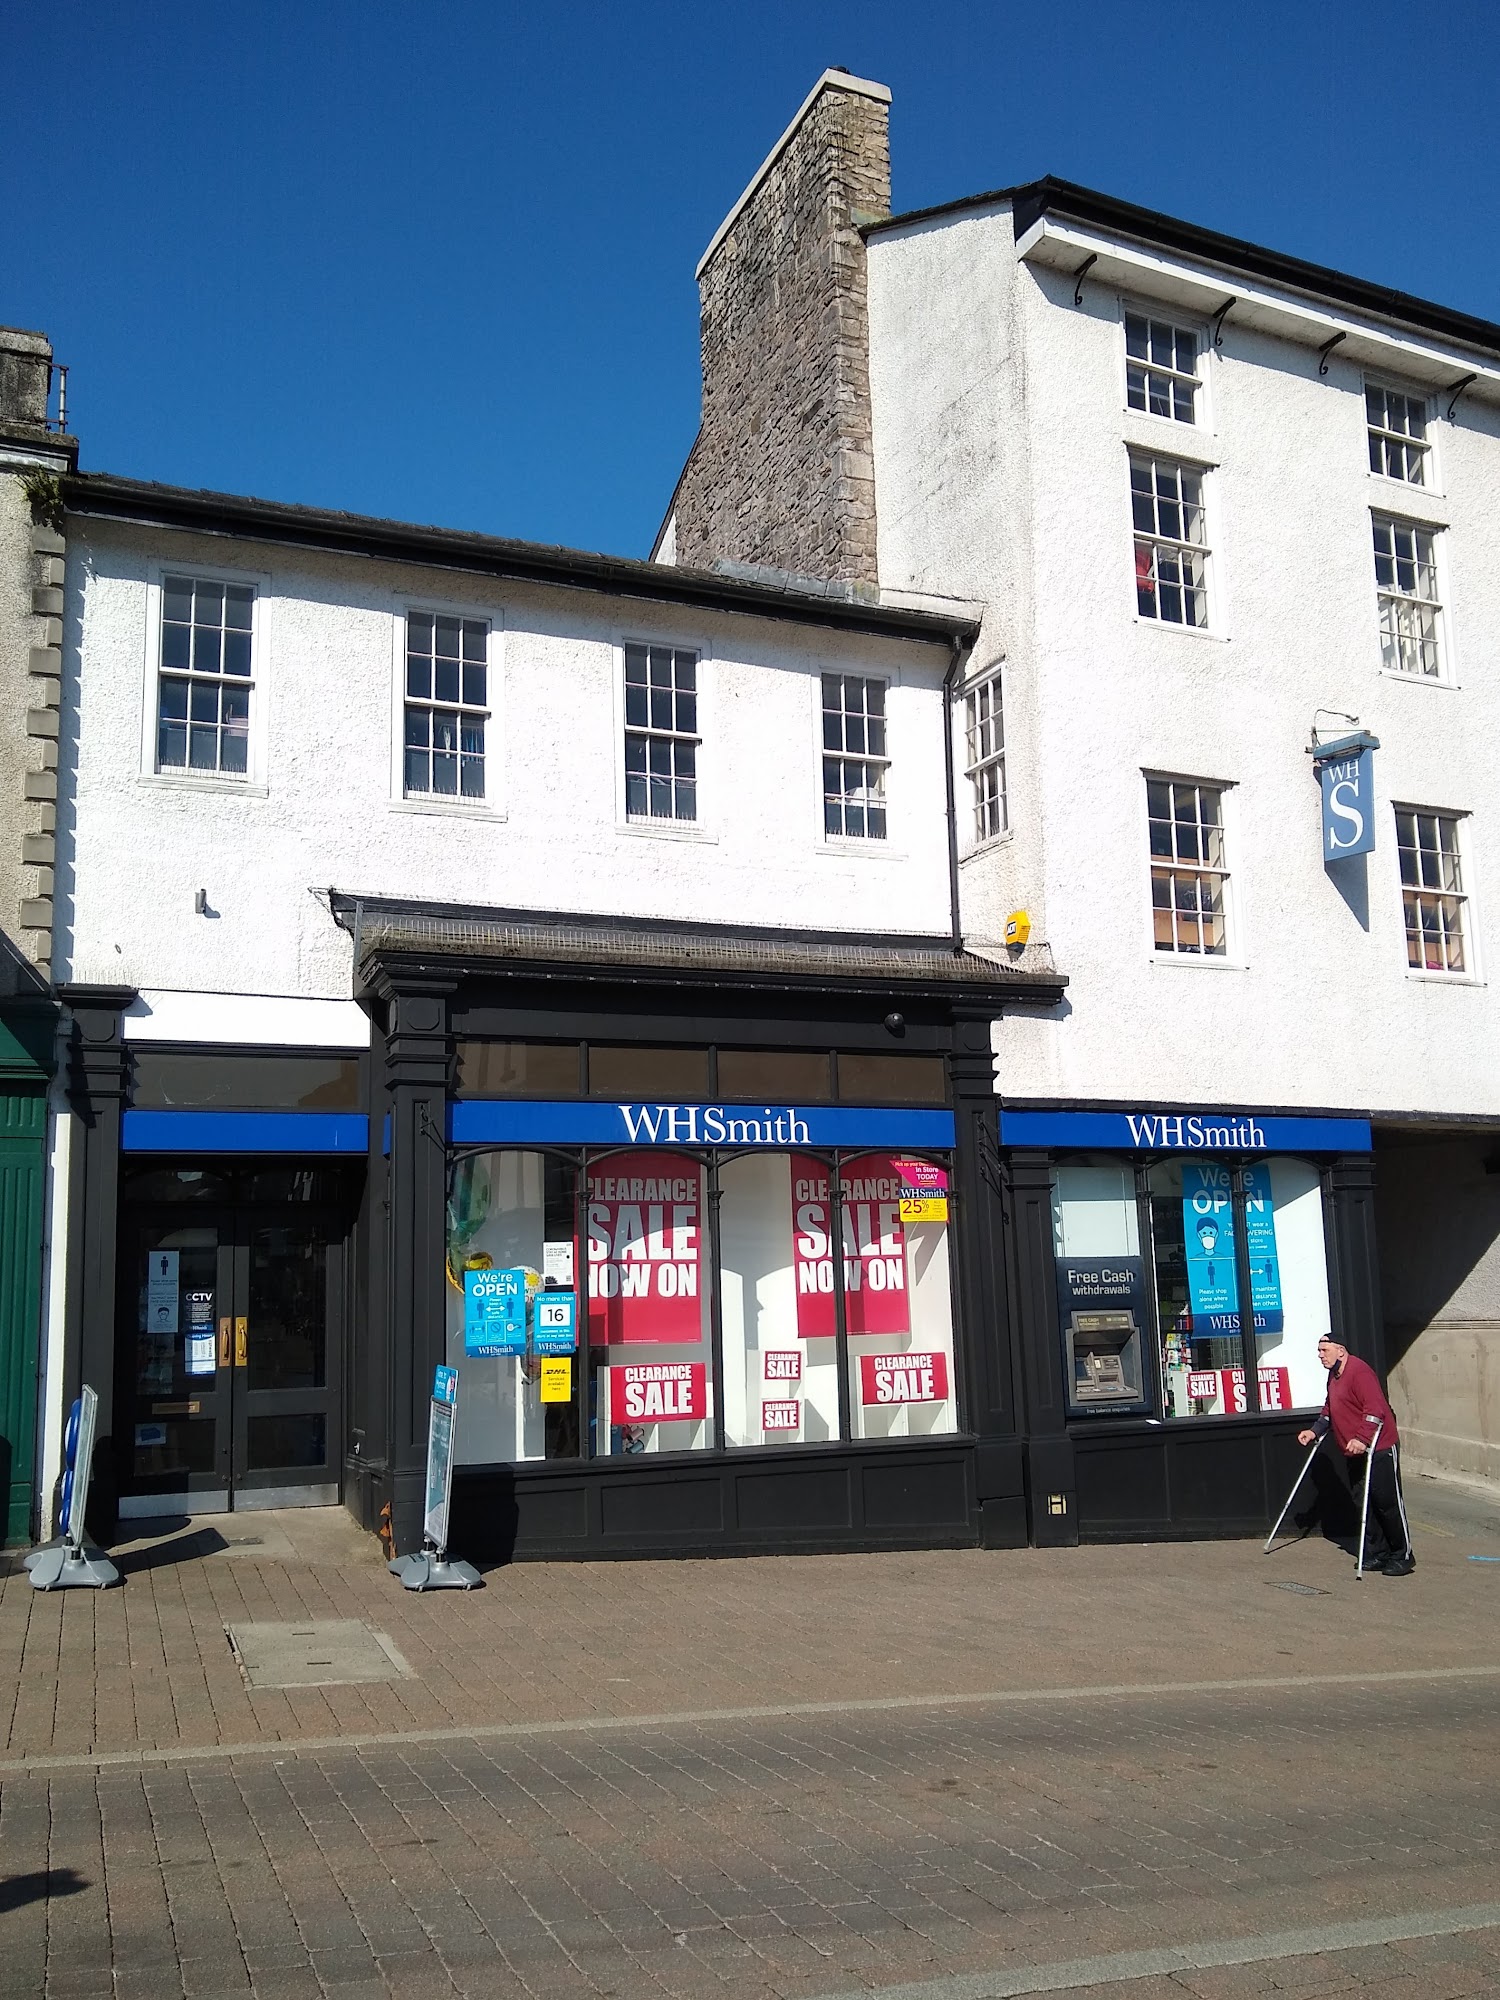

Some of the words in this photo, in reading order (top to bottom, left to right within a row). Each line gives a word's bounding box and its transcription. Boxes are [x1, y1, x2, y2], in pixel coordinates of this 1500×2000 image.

[1328, 759, 1360, 783] WH
[1330, 779, 1364, 850] S
[618, 1105, 812, 1144] WHSmith
[1125, 1115, 1267, 1148] WHSmith
[587, 1177, 697, 1202] CLEARANCE
[795, 1178, 899, 1202] CLERANCE
[900, 1188, 945, 1198] WHSmith
[1192, 1189, 1264, 1214] OPN
[588, 1203, 698, 1261] SALE
[477, 1272, 513, 1283] We're
[657, 1263, 697, 1297] ON
[868, 1258, 904, 1291] ON
[1067, 1270, 1099, 1284] Free
[1101, 1269, 1134, 1283] Cash
[185, 1292, 213, 1301] CCTV
[472, 1282, 518, 1297] OPEN
[1072, 1284, 1131, 1295] withdrawals
[547, 1308, 564, 1322] 16
[478, 1345, 514, 1354] WHSmith
[537, 1342, 572, 1351] WHSmith
[767, 1361, 799, 1378] SALE
[874, 1355, 933, 1371] CLEARANCE
[625, 1365, 692, 1383] CLEARANCE
[875, 1369, 934, 1402] SALE
[1191, 1381, 1216, 1397] SALE
[625, 1380, 693, 1417] SALE
[1233, 1382, 1283, 1413] SLE
[765, 1410, 797, 1428] SALE
